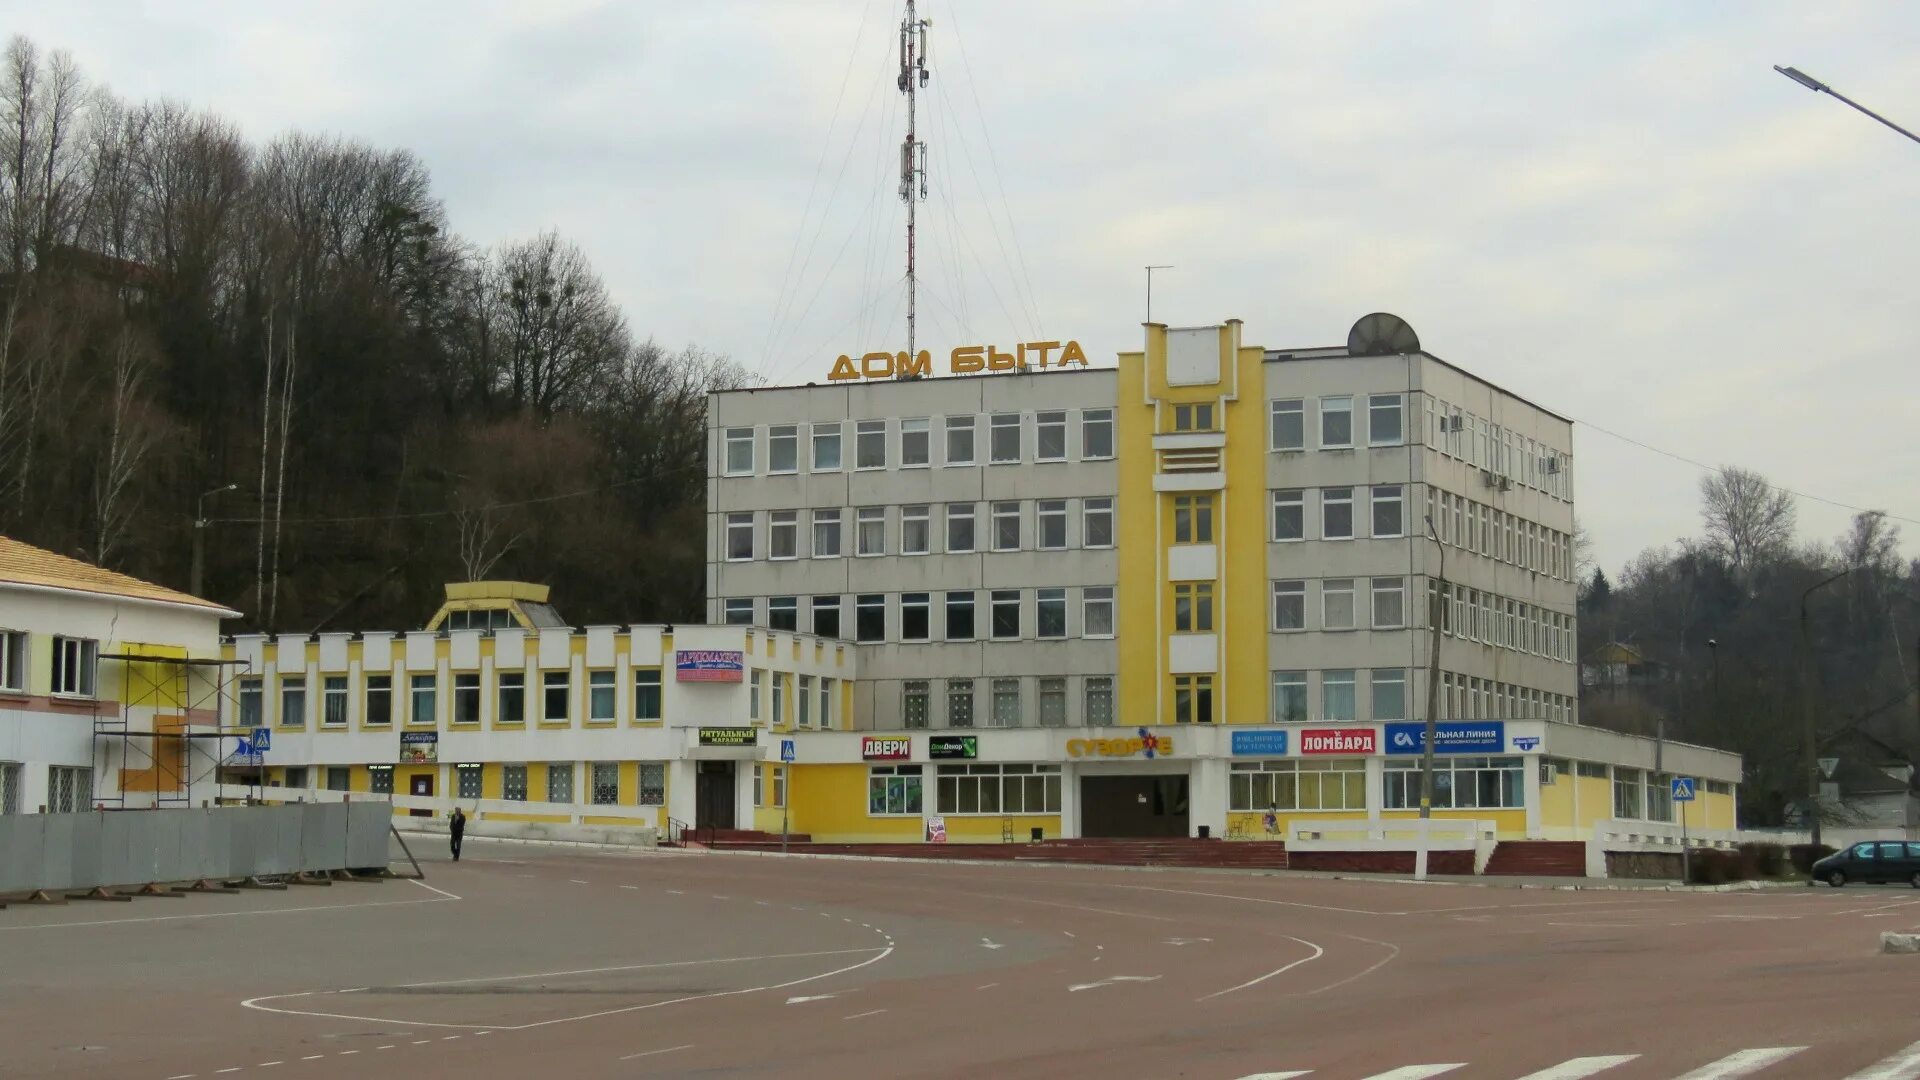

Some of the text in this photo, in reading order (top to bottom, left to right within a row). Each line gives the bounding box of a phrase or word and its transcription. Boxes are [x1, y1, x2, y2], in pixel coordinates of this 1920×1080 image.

[827, 340, 1089, 381] ДОМ БЫТА
[700, 730, 755, 738] РИТУАЛЬНЫЙ
[1420, 730, 1497, 739] СЛЬНАЯ ЛИНИЯ
[864, 740, 909, 756] ДВЕРИ
[931, 743, 963, 751] ДомДекор
[1304, 736, 1373, 751] ЛОМБАРД
